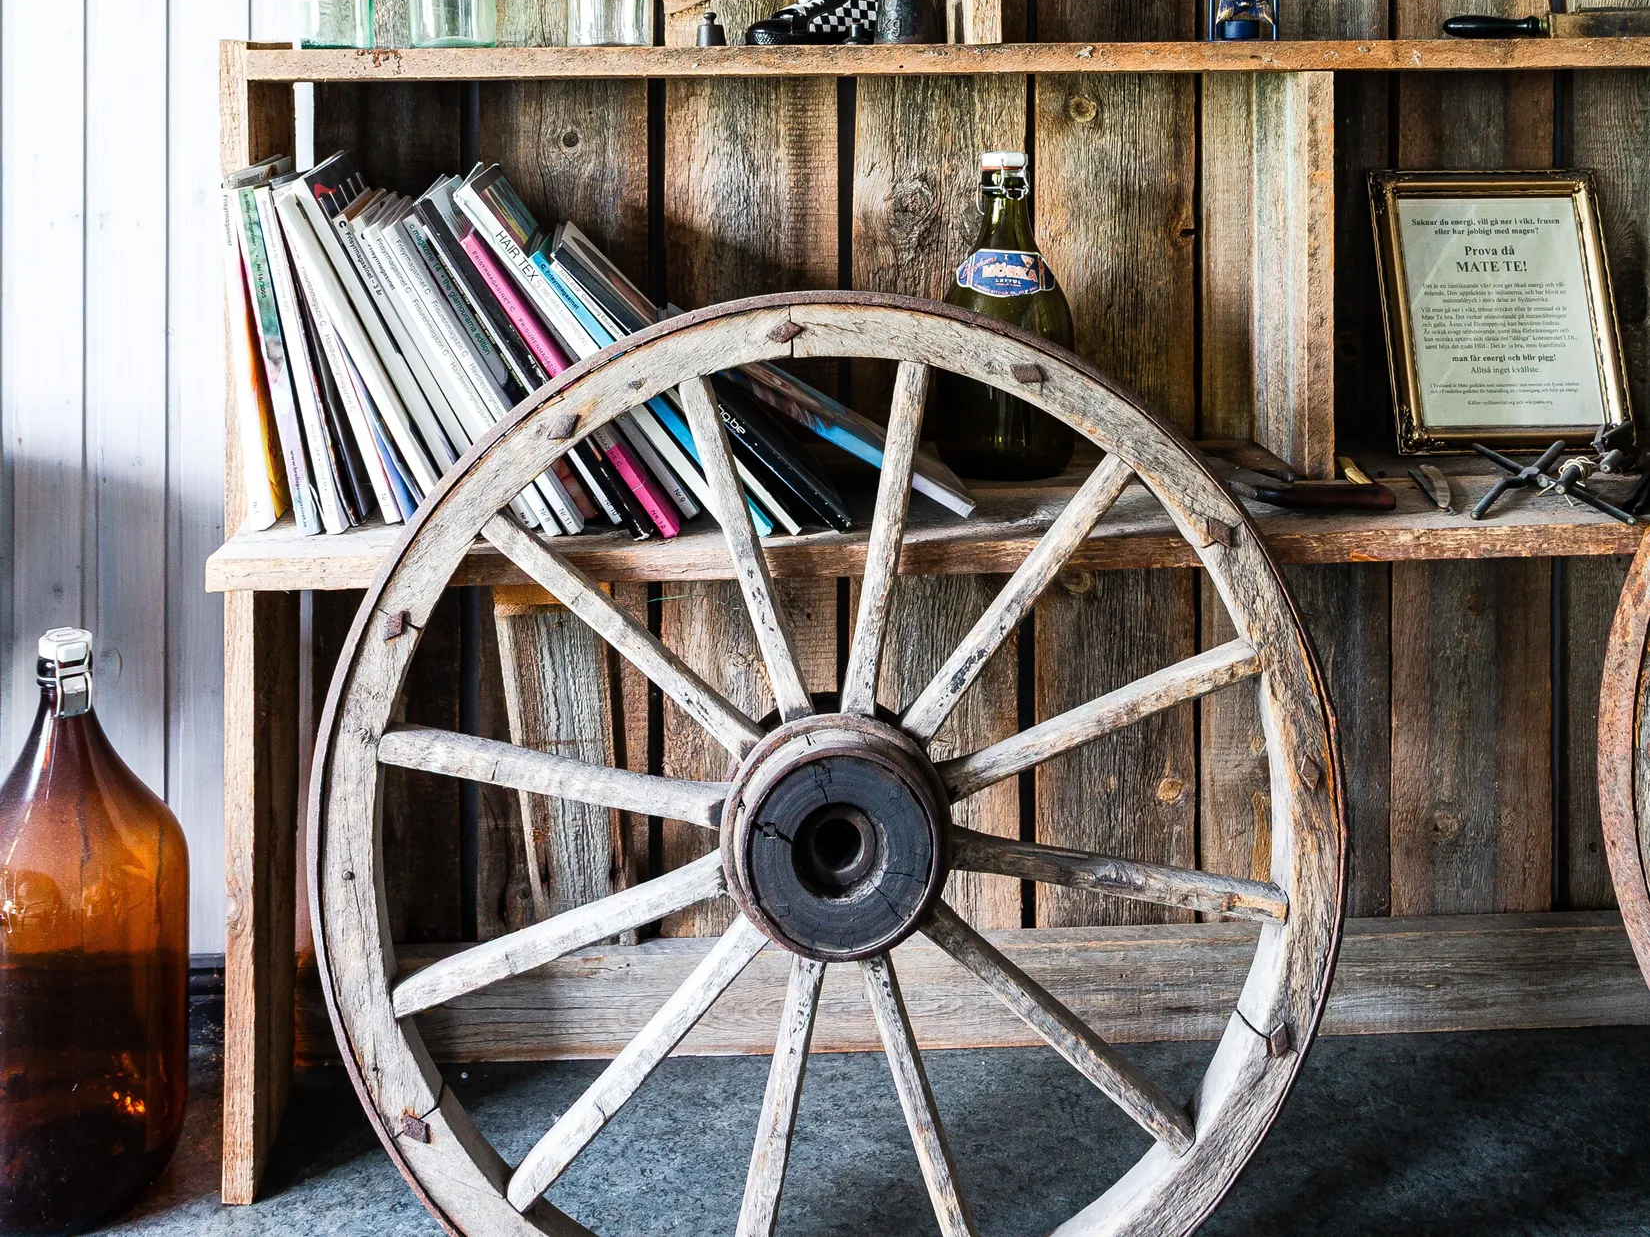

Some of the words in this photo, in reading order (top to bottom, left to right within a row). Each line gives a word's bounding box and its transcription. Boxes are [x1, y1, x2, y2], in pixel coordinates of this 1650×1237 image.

[222, 194, 232, 246] Frisyrmagasinet
[1411, 218, 1437, 226] Saknar
[1450, 218, 1475, 226] energi,
[1490, 218, 1498, 226] gå
[1467, 228, 1492, 236] jobbigt
[1511, 227, 1539, 235] magen?
[1464, 245, 1498, 256] Prova
[1501, 244, 1515, 256] då
[256, 263, 261, 271] Nr
[344, 230, 373, 280] Frisyrmagasinet
[375, 288, 382, 296] år
[494, 230, 521, 259] HAIR
[516, 256, 539, 281] TEX
[533, 278, 544, 289] 5
[548, 296, 561, 310] HAIR
[1456, 261, 1500, 273] MATE
[1503, 260, 1528, 272] TE!
[982, 262, 1038, 283] MÖRKA
[257, 272, 266, 298] 16/2005
[375, 236, 408, 287] Frisyrmagasinet
[410, 297, 444, 349] Frisurenmagazin
[410, 229, 435, 263] magazine
[432, 262, 441, 272] 14
[441, 278, 453, 291] the
[448, 290, 478, 333] glamourama
[473, 332, 492, 355] edition
[544, 269, 580, 310] Frisyrmagasinet
[393, 239, 427, 289] Frisyrmagasinet
[429, 299, 464, 350] Frisurenmagazin
[579, 293, 602, 316] Continuing
[600, 314, 620, 335] Education
[1483, 354, 1506, 363] energi
[1538, 354, 1557, 362] pigg!
[1471, 366, 1491, 374] Alltså
[1493, 367, 1510, 375] inget
[673, 488, 683, 498] Nr
[519, 511, 527, 520] Nr
[539, 507, 547, 517] Nr
[558, 507, 567, 517] Nr
[563, 516, 572, 526] 11
[657, 520, 666, 529] 12
